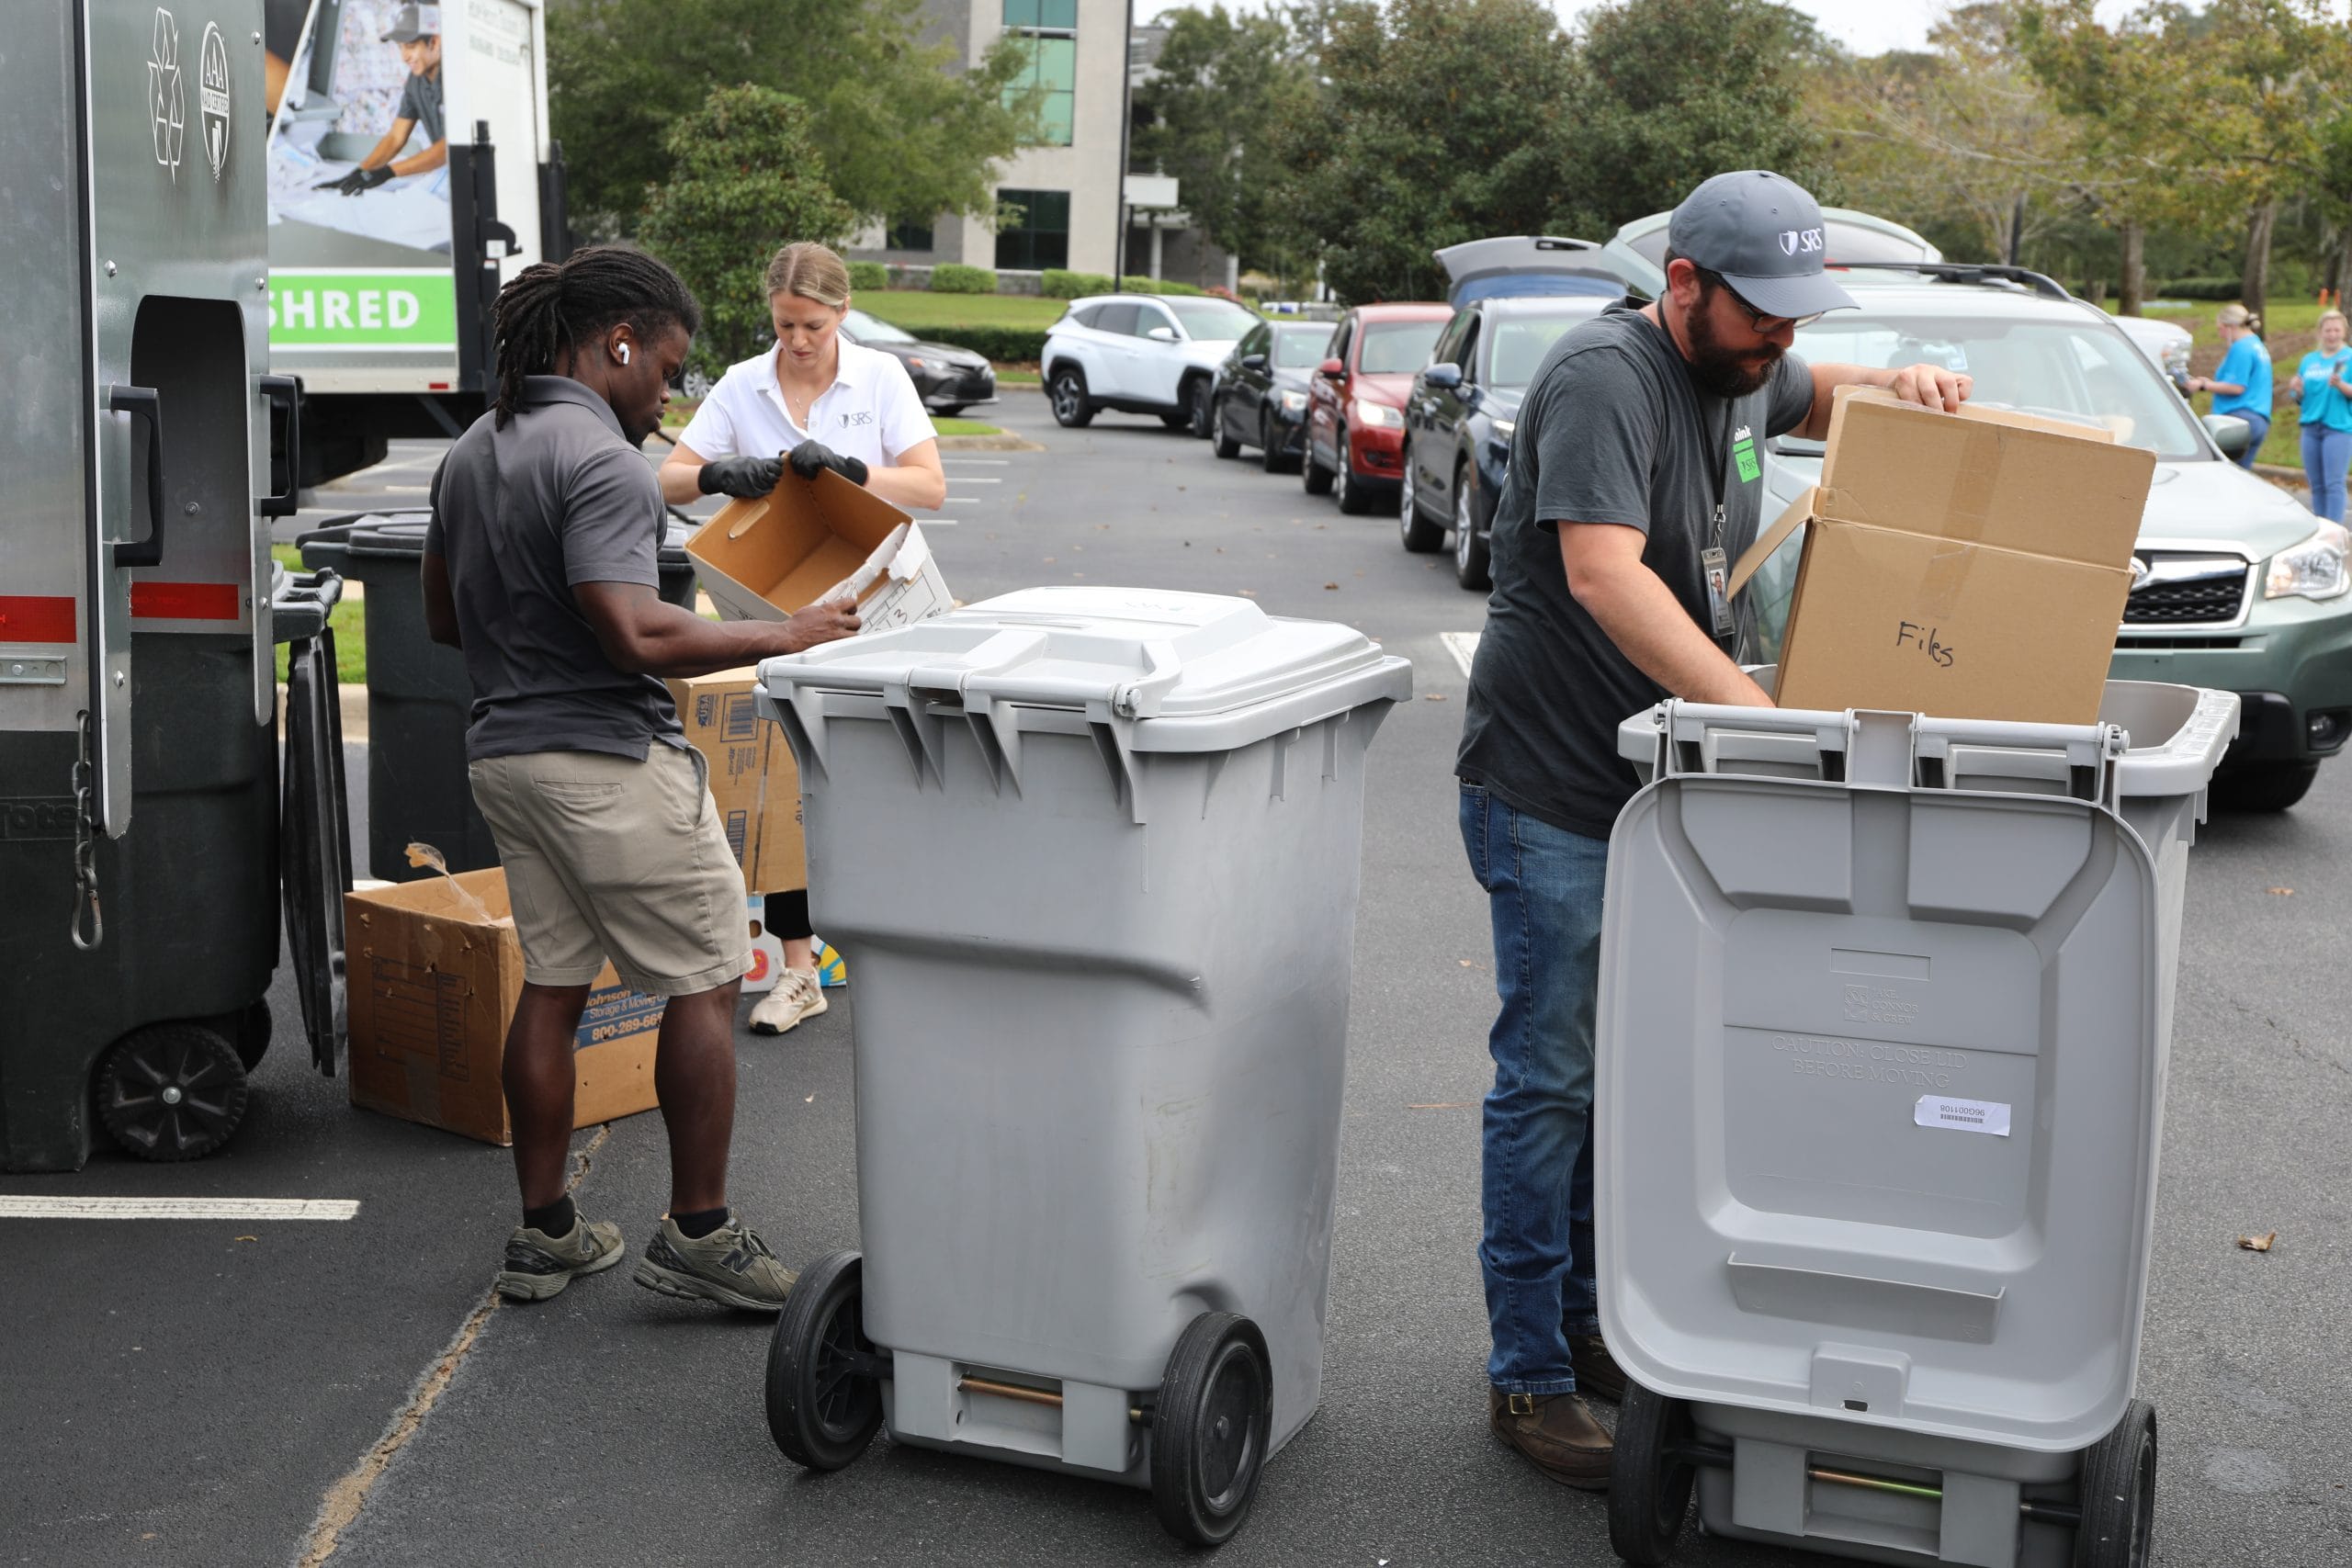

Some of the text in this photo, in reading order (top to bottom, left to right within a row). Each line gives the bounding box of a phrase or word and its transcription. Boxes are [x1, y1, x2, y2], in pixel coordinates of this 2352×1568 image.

[205, 42, 224, 89] AAA
[1800, 228, 1823, 253] SRS
[851, 411, 873, 426] SRS
[1896, 621, 1953, 668] Files
[699, 695, 709, 716] USA
[590, 1005, 619, 1020] Storage
[621, 1002, 628, 1011] &
[629, 995, 656, 1008] Moving
[1771, 1035, 1968, 1069] CAUTION: CLOSE LID
[1792, 1058, 1951, 1088] BEFORE MOVING
[1940, 1104, 1985, 1117] 96G001108
